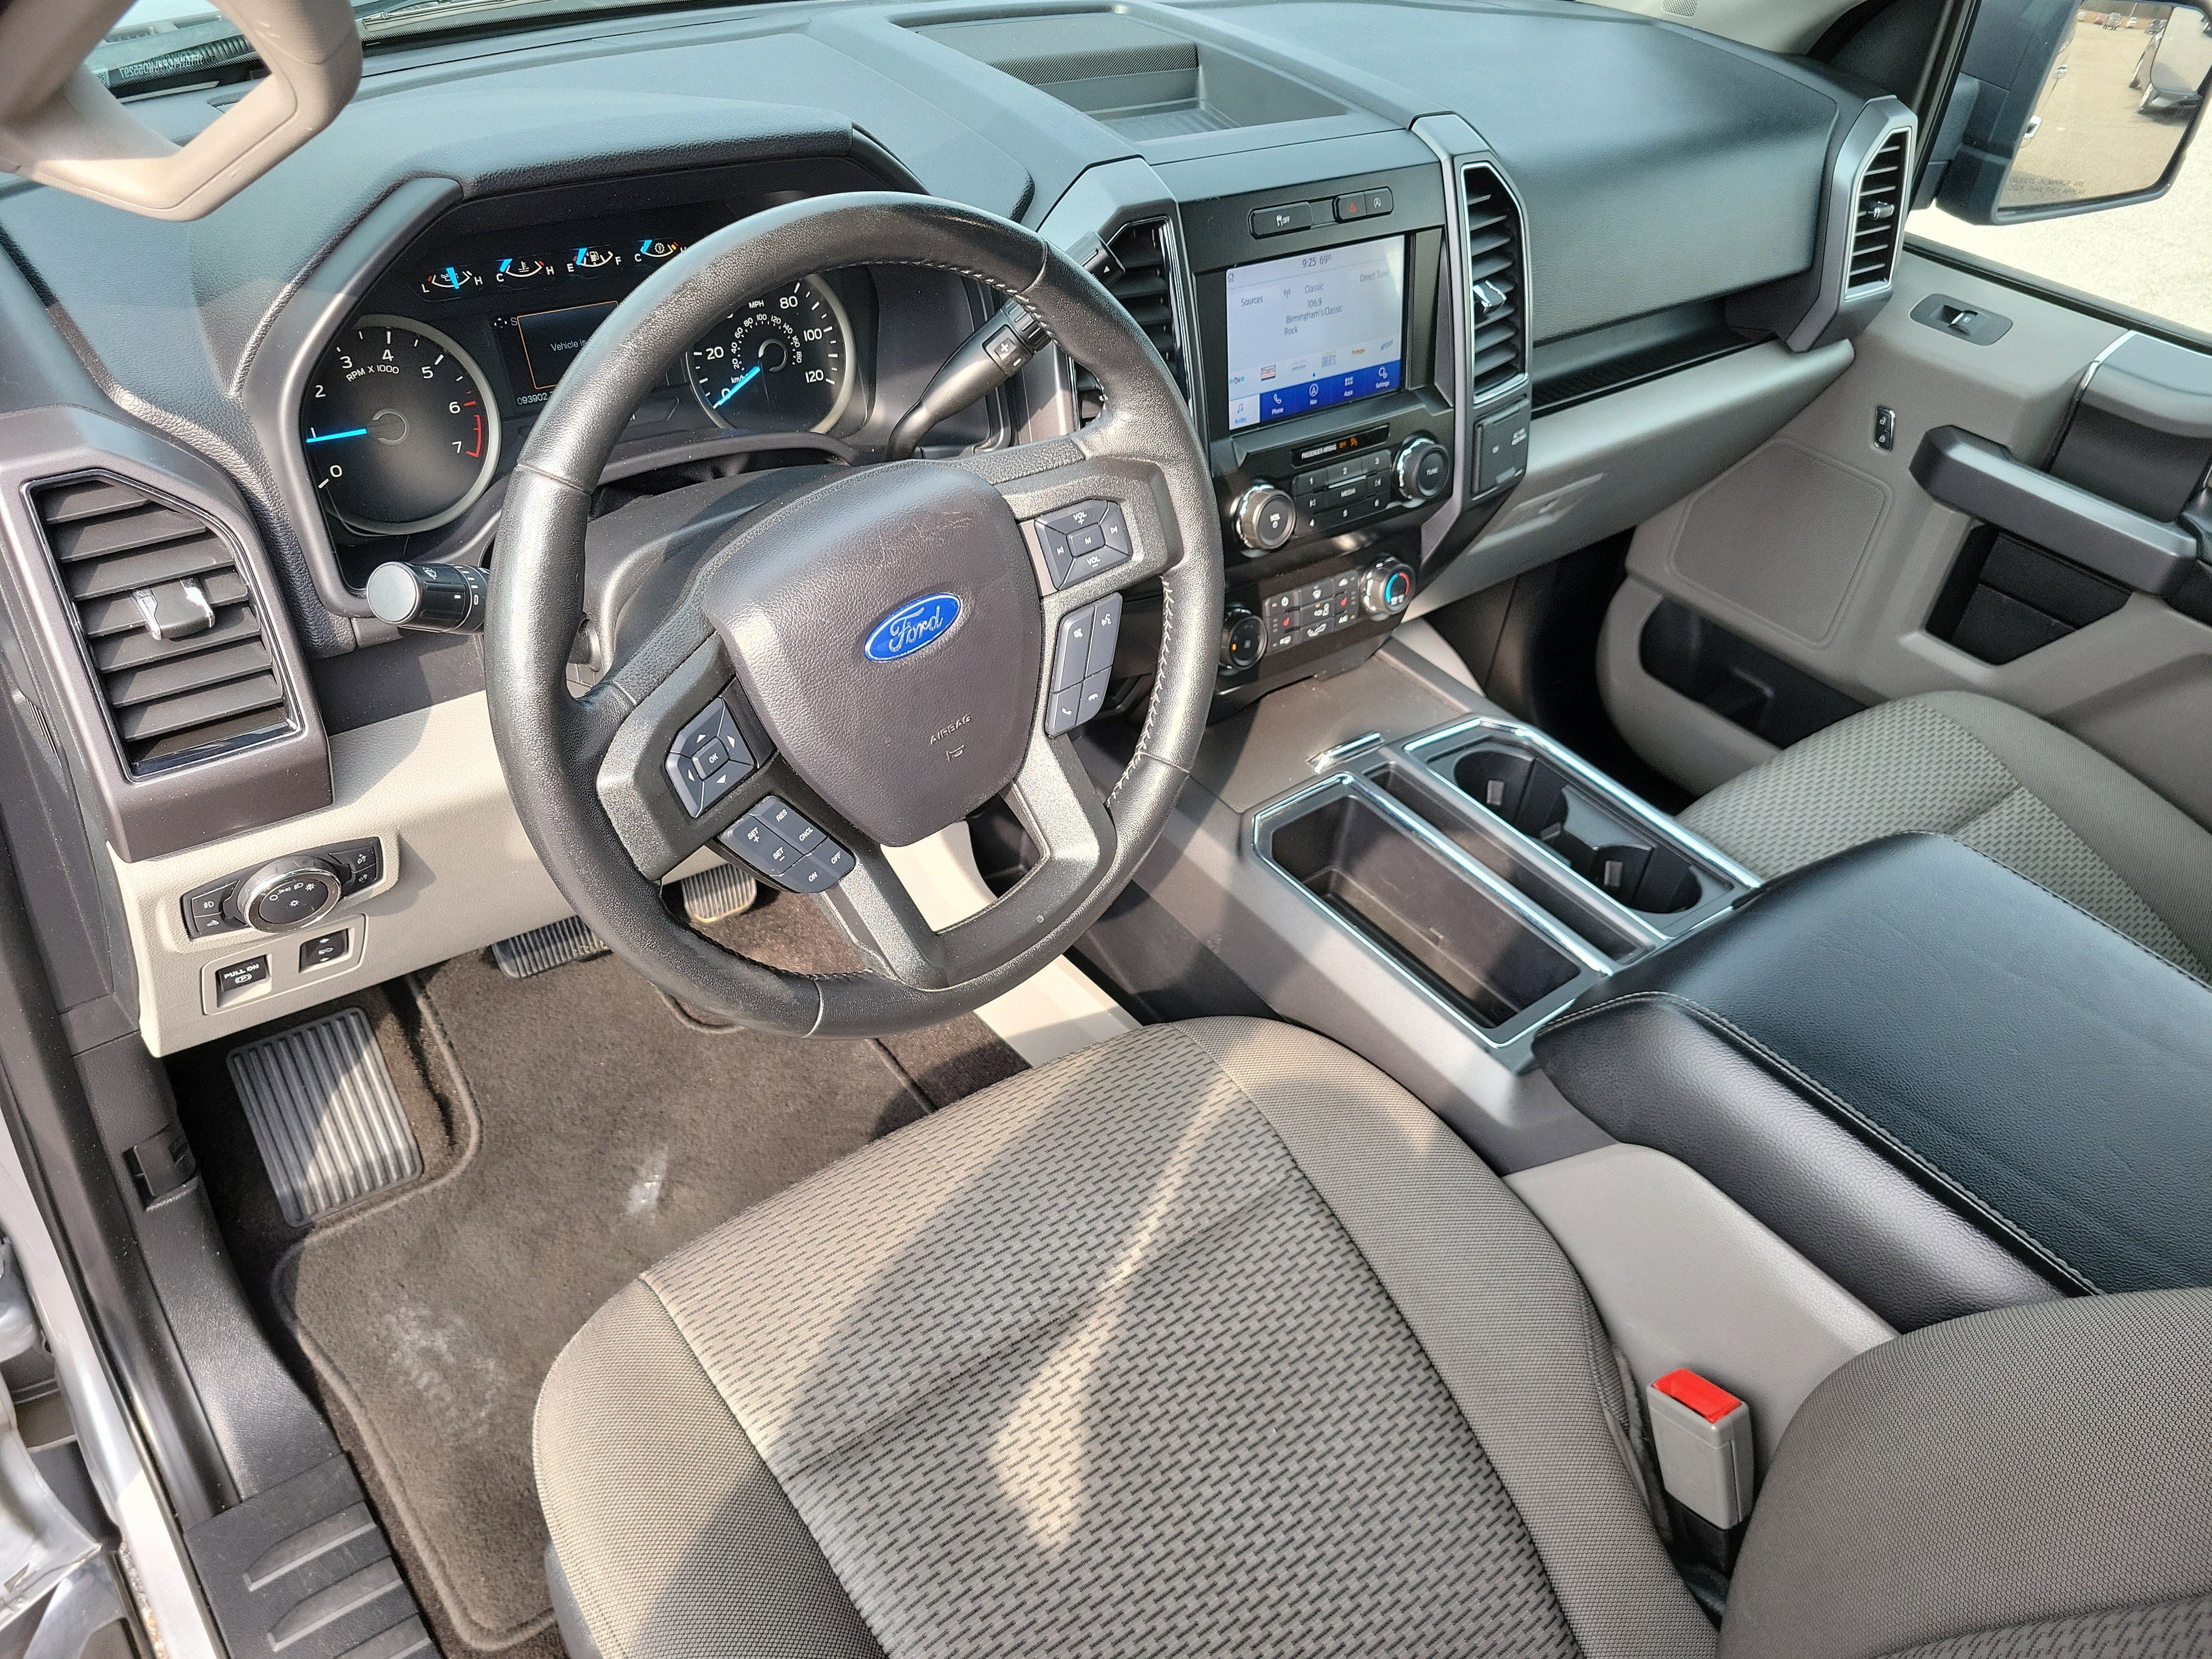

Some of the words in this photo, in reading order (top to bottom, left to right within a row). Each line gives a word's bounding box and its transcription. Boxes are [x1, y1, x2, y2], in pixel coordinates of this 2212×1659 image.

[1282, 216, 1290, 224] OFF
[615, 256, 622, 266] F
[634, 253, 642, 262] C
[1302, 257, 1317, 268] 9:25
[546, 266, 555, 275] H
[566, 263, 574, 272] E
[474, 276, 483, 286] H
[496, 273, 505, 283] C
[1359, 272, 1375, 283] Direct
[421, 284, 430, 294] L
[1304, 283, 1324, 294] Classic
[748, 299, 764, 309] MPH
[780, 296, 798, 309] 80
[1240, 296, 1263, 307] Sources
[1307, 298, 1322, 308] 106.9
[771, 314, 782, 324] 120
[1286, 309, 1324, 324] Birmingham's
[1324, 305, 1343, 316] Classic
[510, 317, 517, 326] S
[743, 317, 753, 327] 80
[735, 327, 743, 338] 60
[783, 322, 793, 334] 140
[1284, 326, 1299, 336] Rock
[803, 328, 822, 342] 100
[550, 340, 578, 351] Vehicle
[792, 335, 800, 348] 160
[706, 346, 724, 360] 20
[731, 342, 738, 354] 40
[382, 349, 394, 362] 4
[340, 356, 353, 369] 3
[732, 358, 740, 370] 20
[346, 368, 366, 382] RPM
[368, 365, 375, 374] X
[377, 364, 400, 374] 1000
[421, 366, 434, 379] 5
[805, 369, 824, 383] 120
[315, 385, 326, 398] 2
[517, 393, 548, 405] 093902
[449, 401, 461, 414] 6
[452, 441, 462, 454] 7
[1301, 448, 1323, 459] PASSENGER
[1323, 443, 1338, 453] AIRBAG
[1374, 456, 1380, 465] 3
[330, 465, 342, 477] 0
[1342, 466, 1348, 475] 2
[1309, 477, 1314, 485] 1
[1340, 487, 1357, 497] MEDIA
[1073, 511, 1087, 521] VOL
[1309, 518, 1315, 527] 4
[1085, 537, 1092, 545] M
[1086, 555, 1101, 566] VOL
[889, 605, 944, 653] Ford
[930, 714, 972, 745] AIRBAG
[709, 753, 719, 764] OK
[776, 809, 788, 822] RES
[747, 827, 759, 840] SET
[799, 827, 814, 842] CNCL
[772, 847, 785, 860] SET
[831, 851, 842, 864] OFF
[808, 871, 818, 882] ON
[224, 969, 246, 979] PULL
[246, 963, 259, 972] ON
